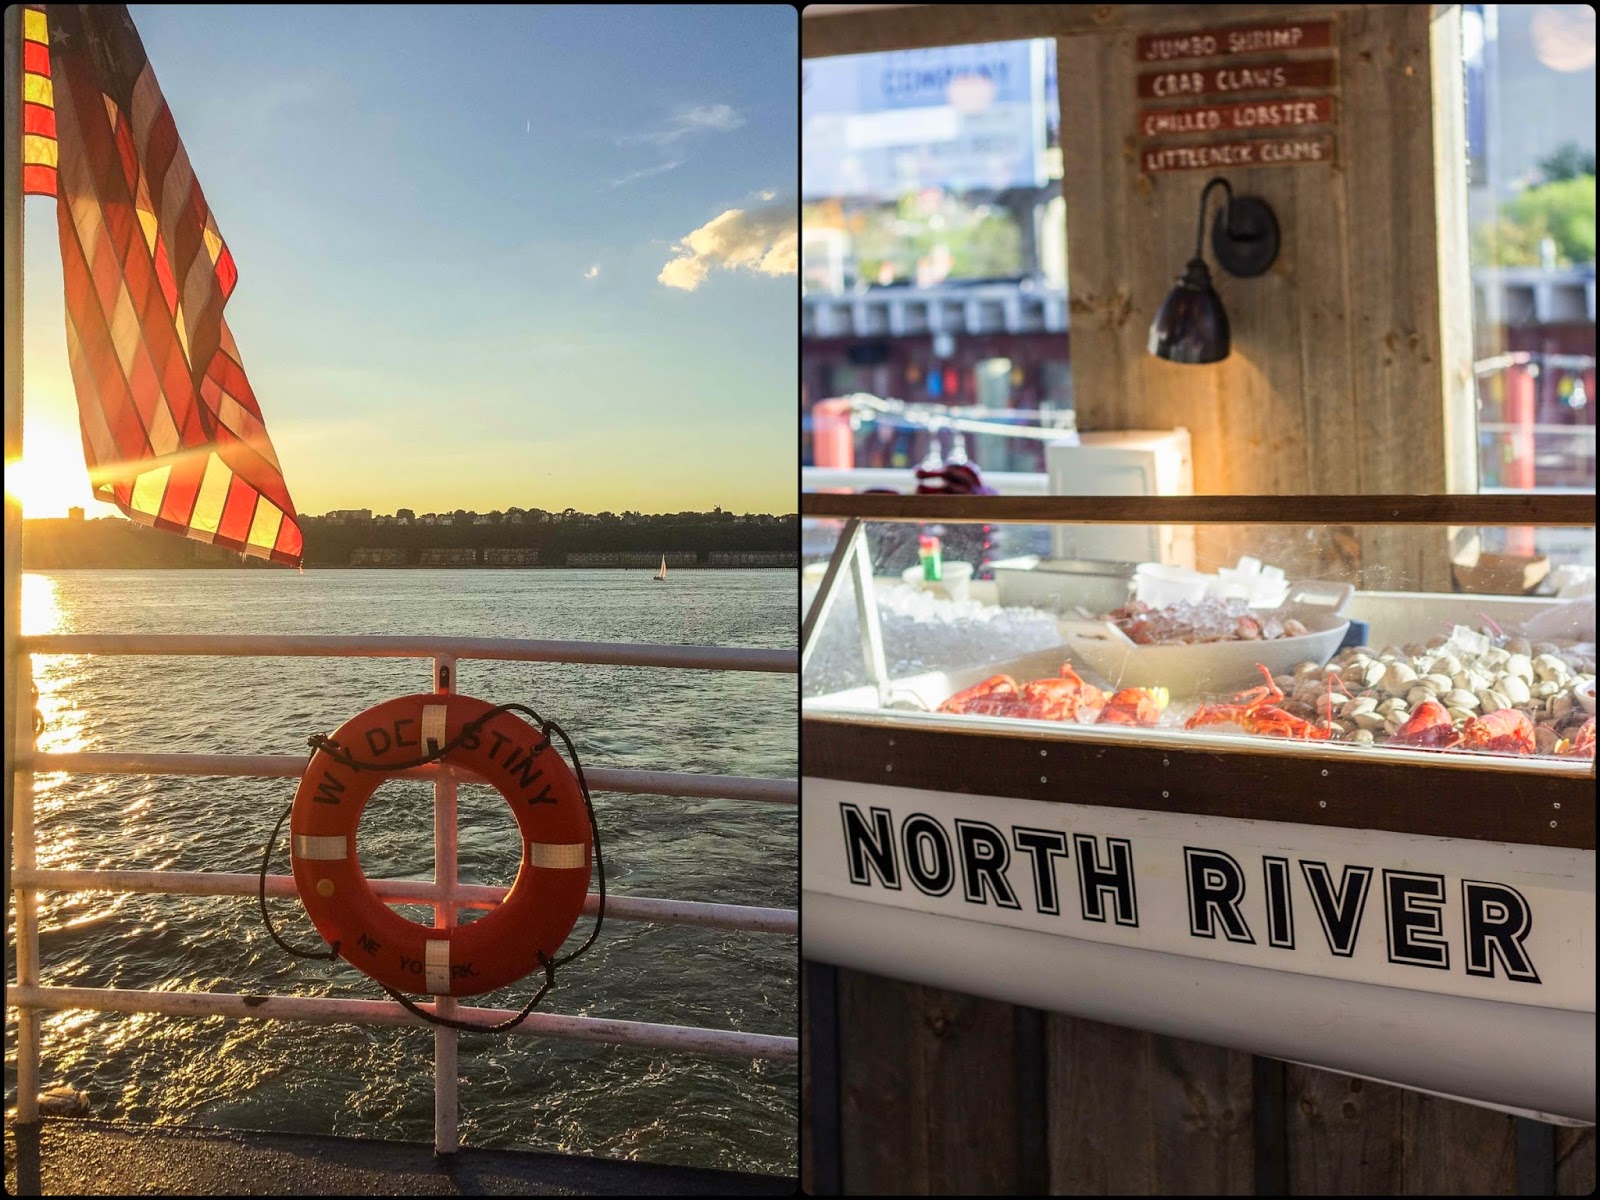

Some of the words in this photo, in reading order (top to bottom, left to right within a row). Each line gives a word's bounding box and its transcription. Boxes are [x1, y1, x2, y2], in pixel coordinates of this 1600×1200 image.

[1145, 35, 1217, 60] JUMBO
[1227, 27, 1304, 53] SHRIMP
[1152, 72, 1205, 97] CRAB
[1215, 67, 1287, 91] CLAWS
[1144, 110, 1221, 136] CHILLED
[1232, 102, 1319, 127] LOBSTER
[1146, 144, 1253, 170] LITTLENECK
[1259, 141, 1322, 162] CLAMS
[839, 802, 1140, 929] NORTH
[1182, 845, 1543, 985] RIVER
